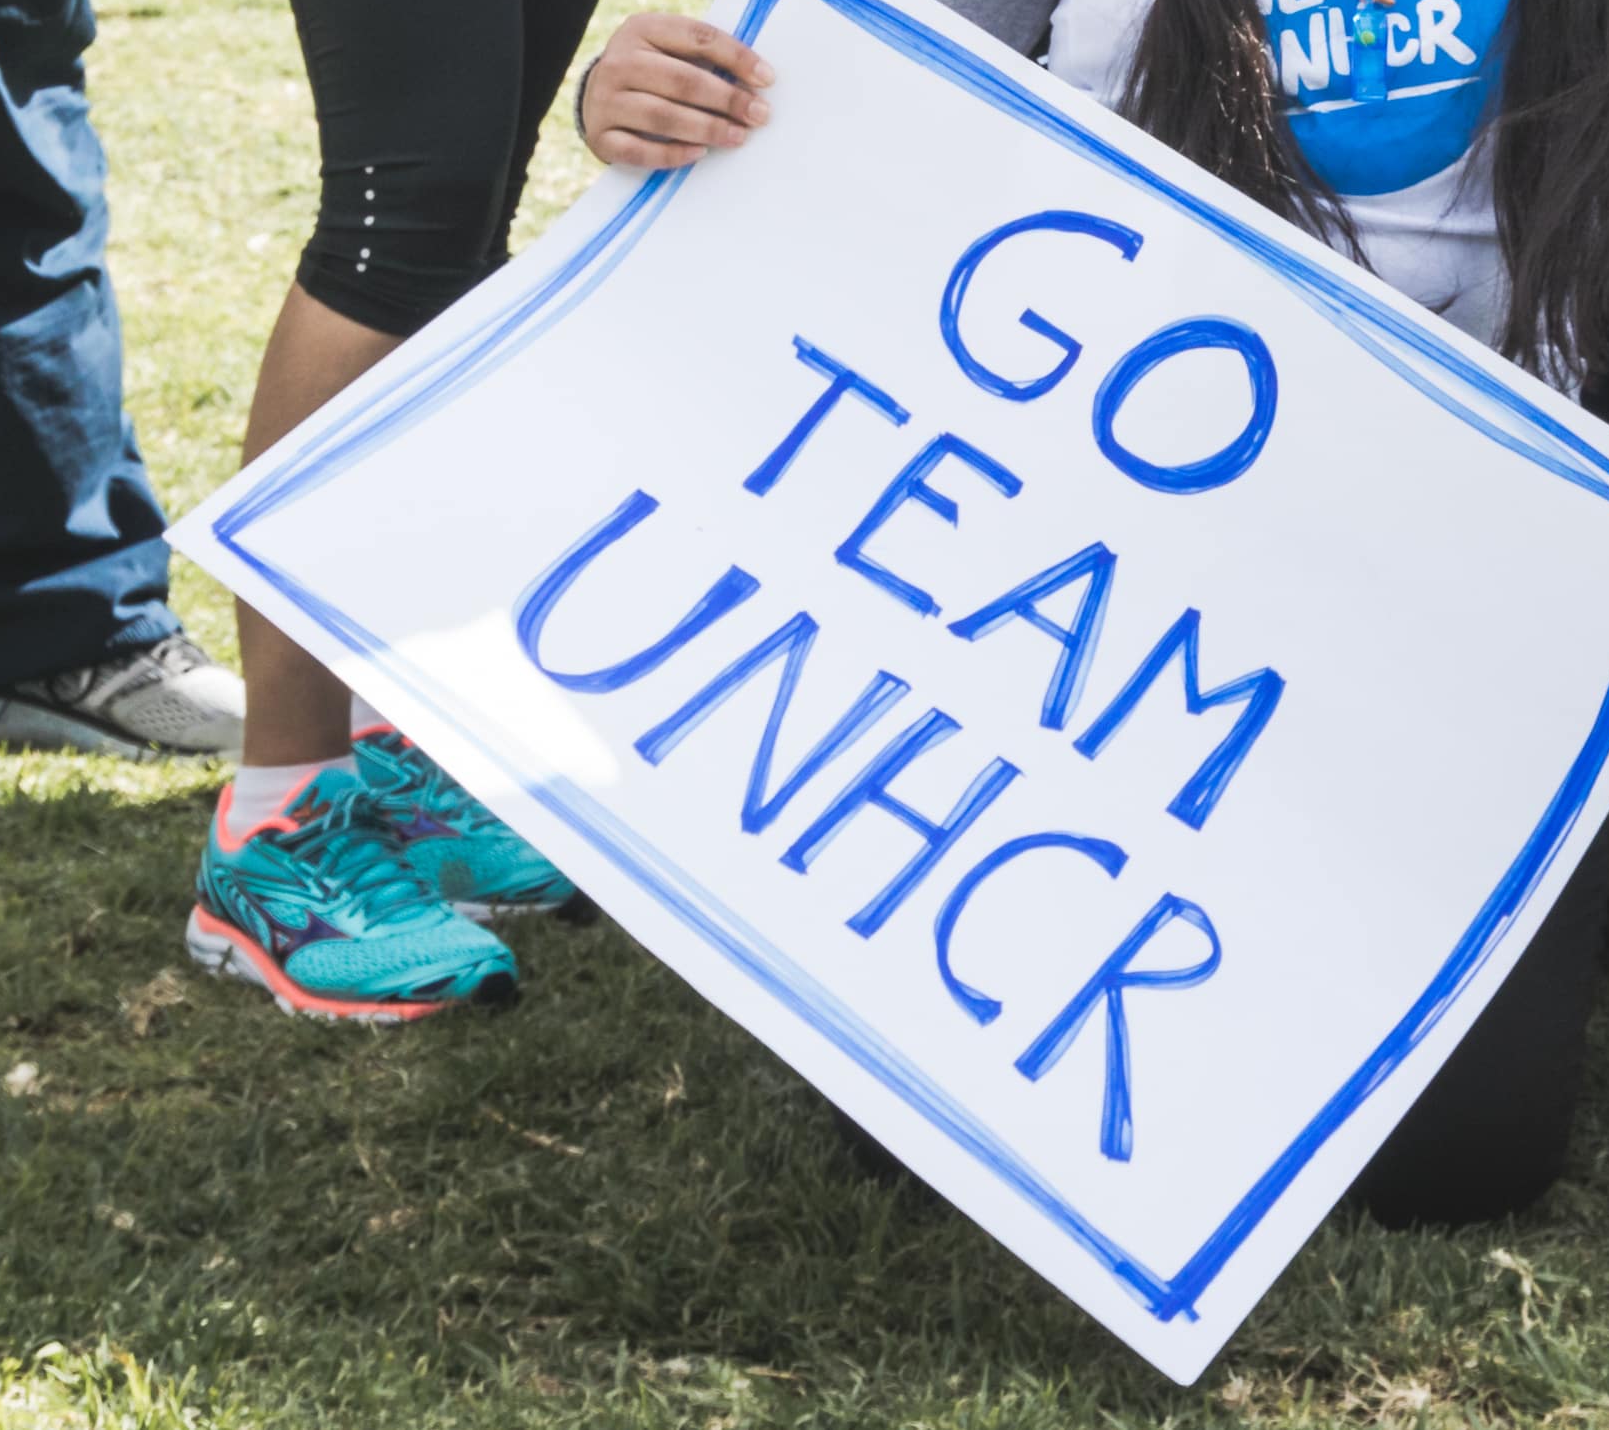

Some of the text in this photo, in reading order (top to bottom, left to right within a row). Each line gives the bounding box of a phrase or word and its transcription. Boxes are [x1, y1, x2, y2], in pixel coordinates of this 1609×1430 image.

[744, 335, 1285, 831] TEAM
[938, 210, 1278, 494] GO
[515, 489, 1222, 1163] UNHCR
